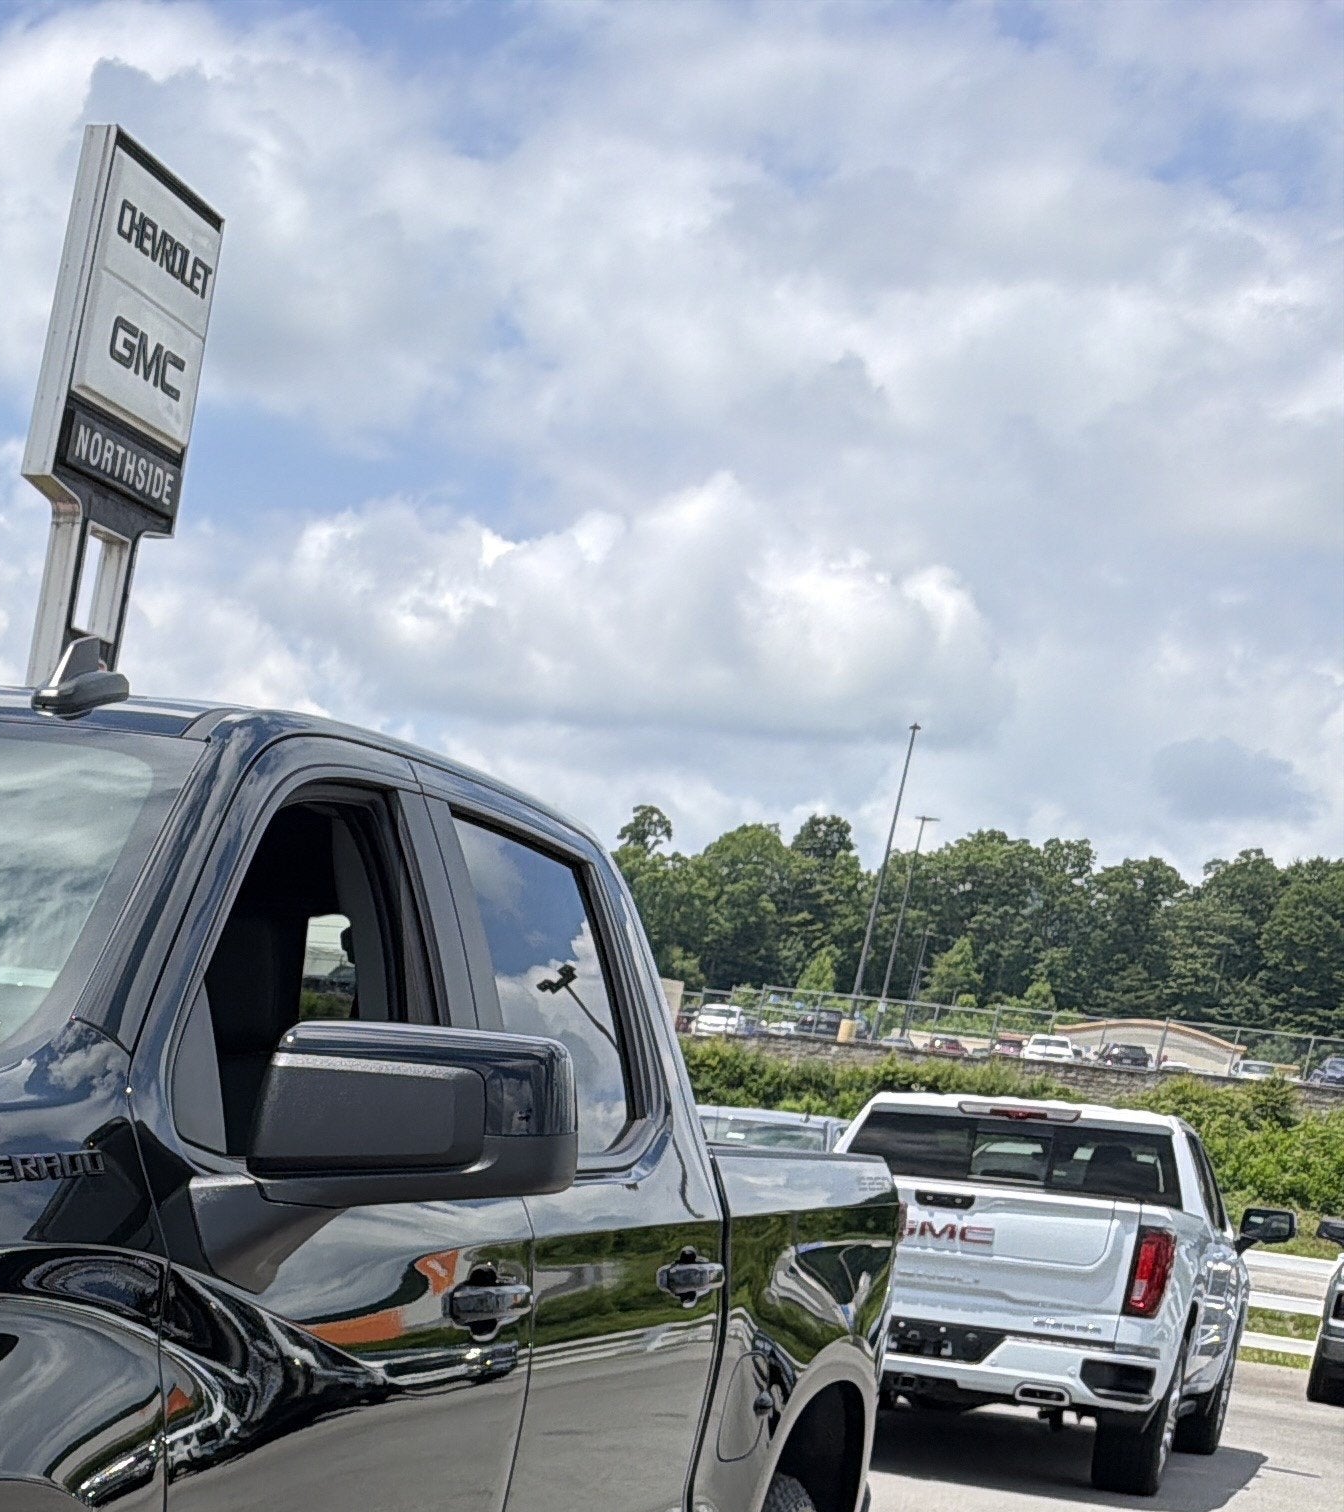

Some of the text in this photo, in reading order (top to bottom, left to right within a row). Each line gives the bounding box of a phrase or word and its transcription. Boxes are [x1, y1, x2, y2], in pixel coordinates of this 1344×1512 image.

[117, 198, 213, 300] CHEVROLET
[110, 315, 186, 402] GMC
[75, 424, 174, 505] NORTHSIDE
